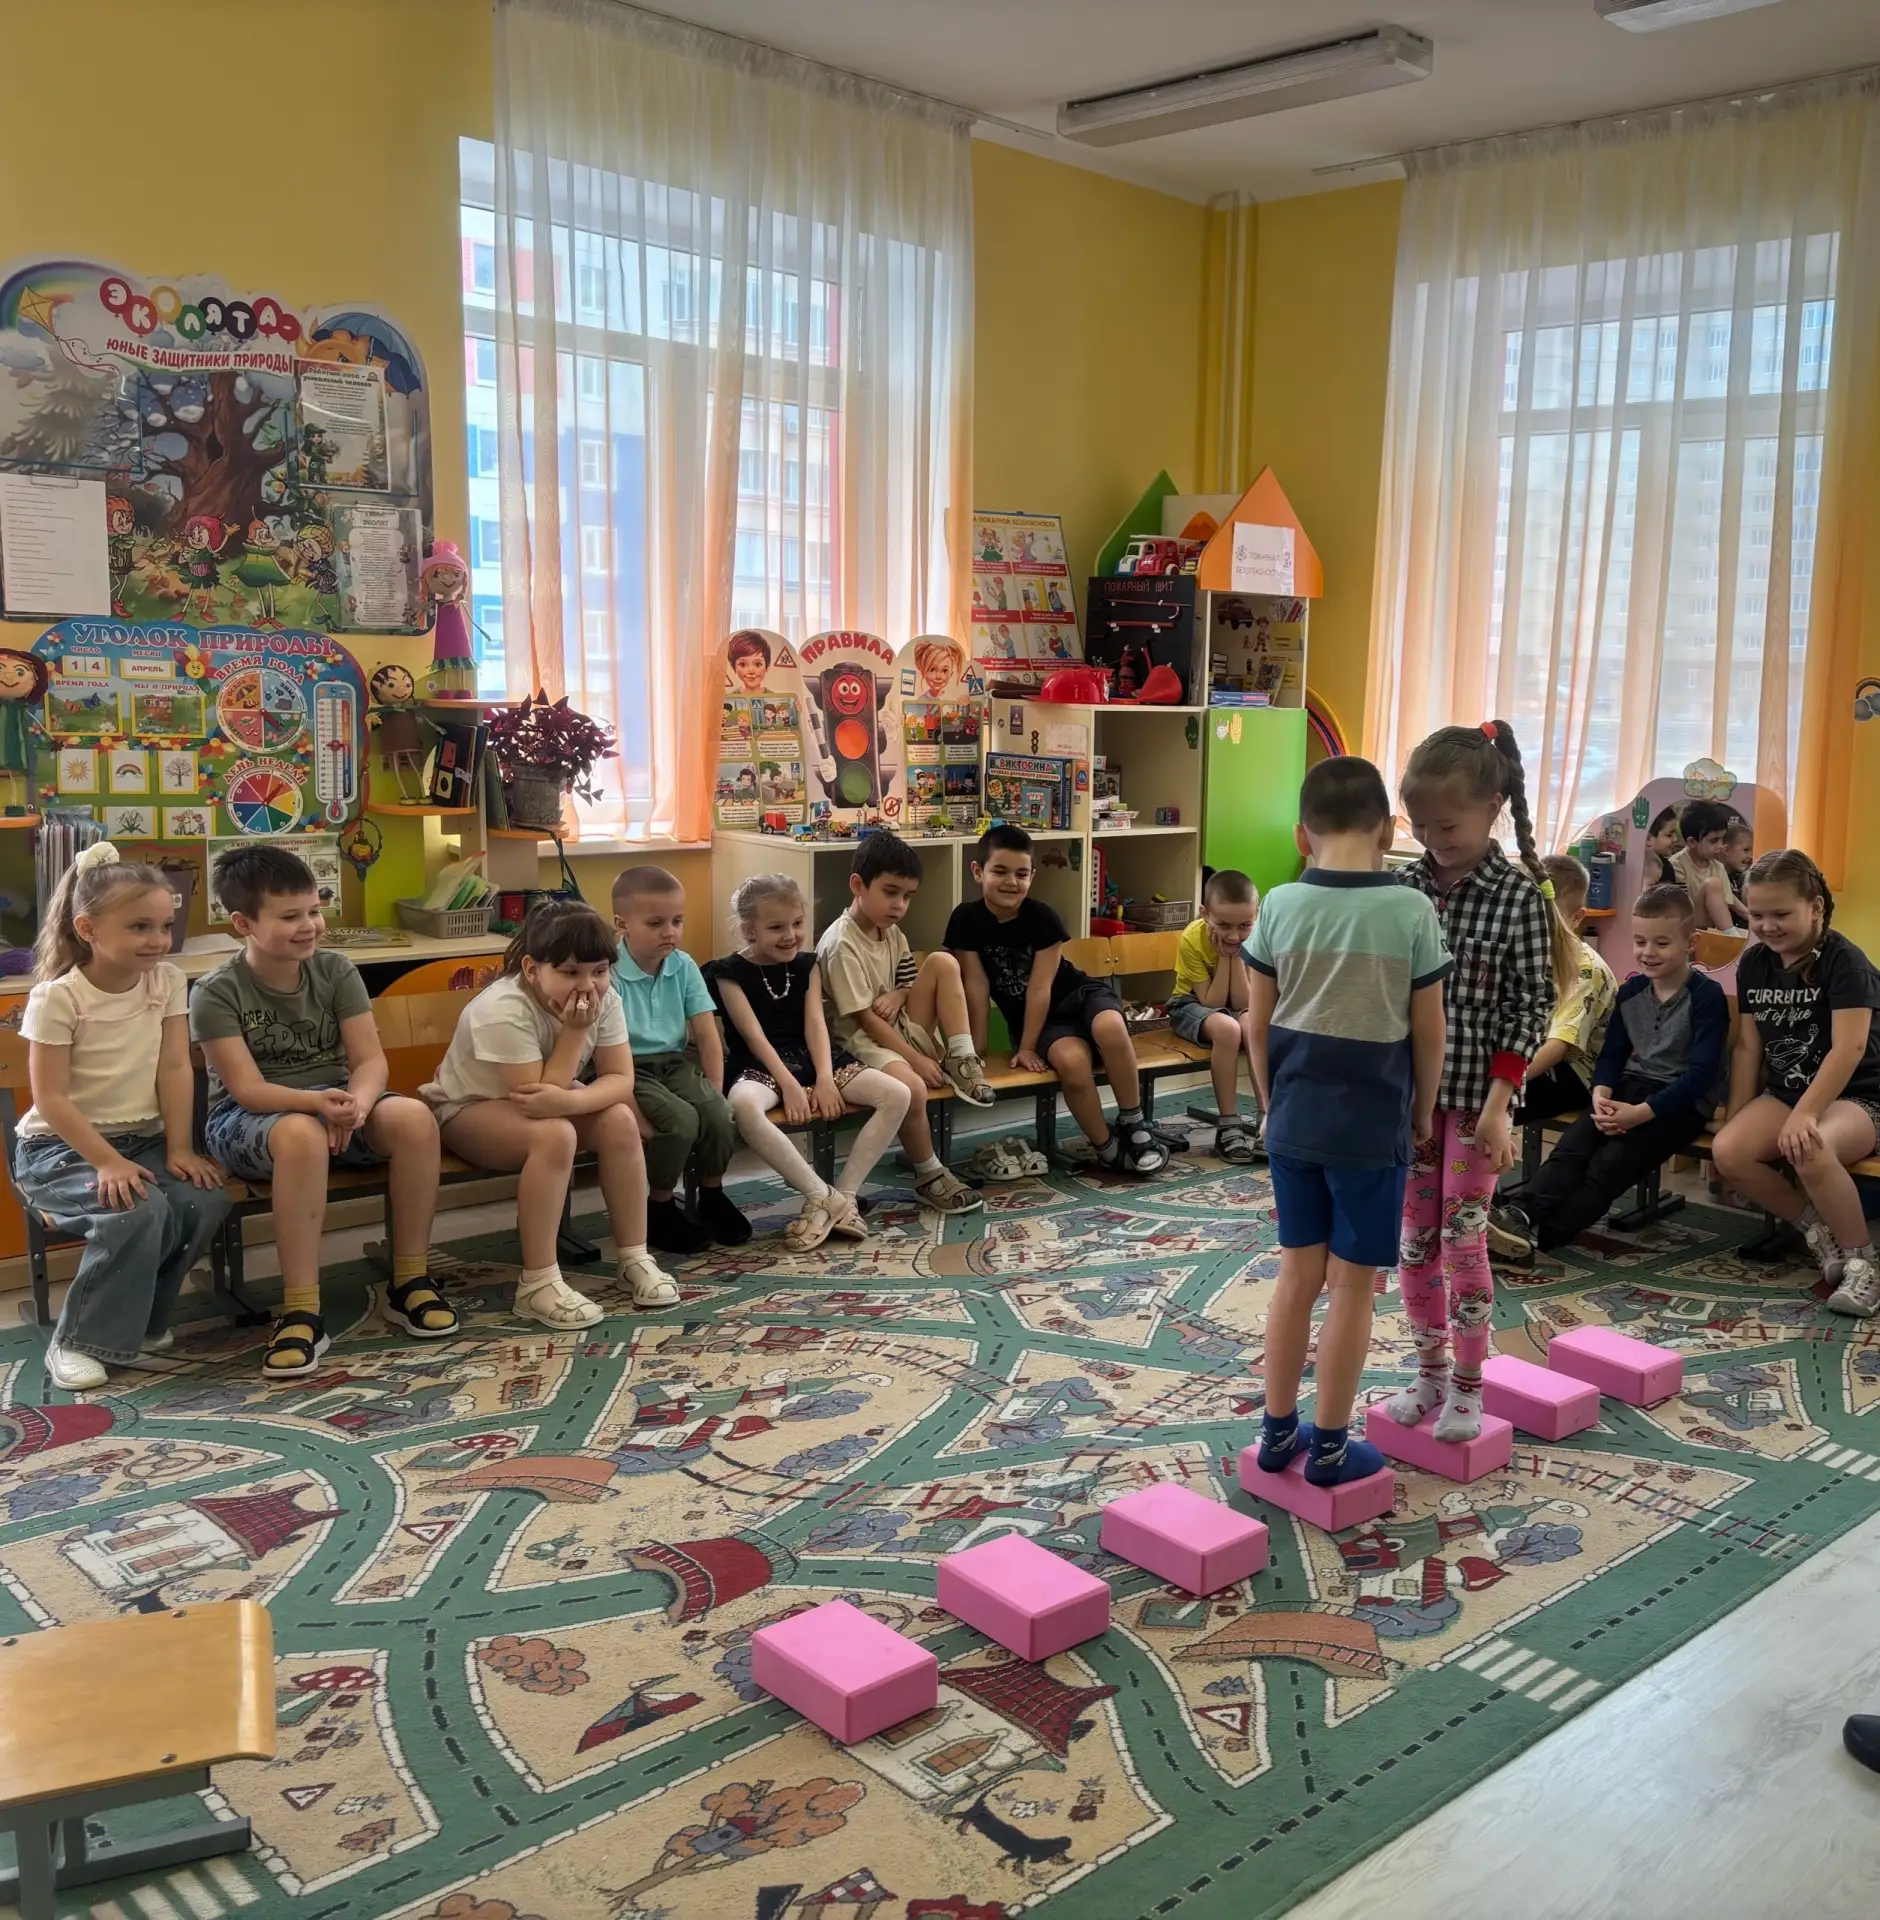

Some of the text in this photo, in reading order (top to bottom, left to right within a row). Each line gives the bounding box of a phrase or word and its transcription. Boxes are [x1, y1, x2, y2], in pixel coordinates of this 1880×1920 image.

[106, 337, 292, 374] ЮНЫЕ ЗАЩИТНИКИ ПРИРОДЫ
[1236, 566, 1278, 577] БЕЗОПАСНОСТ
[1104, 580, 1175, 594] ПОЖАРНЫЙ ЩИТ
[71, 622, 332, 657] УГОЛОК ПРИРОДЫ
[71, 645, 101, 654] ЧИСЛО
[800, 632, 894, 666] ПРАВИЛА
[131, 664, 164, 673] АПРЕЛЬ
[213, 655, 304, 685] ВРЕМЯ ГОДА
[55, 679, 110, 688] ВРЕМЯ ГОДА
[161, 684, 200, 692] ПРИРОДА
[223, 757, 308, 785] ДЕНЬ НЕДЕЛИ
[1000, 758, 1053, 773] ВИКТОРИНА
[1754, 1007, 1778, 1021] out
[1772, 1008, 1787, 1027] of
